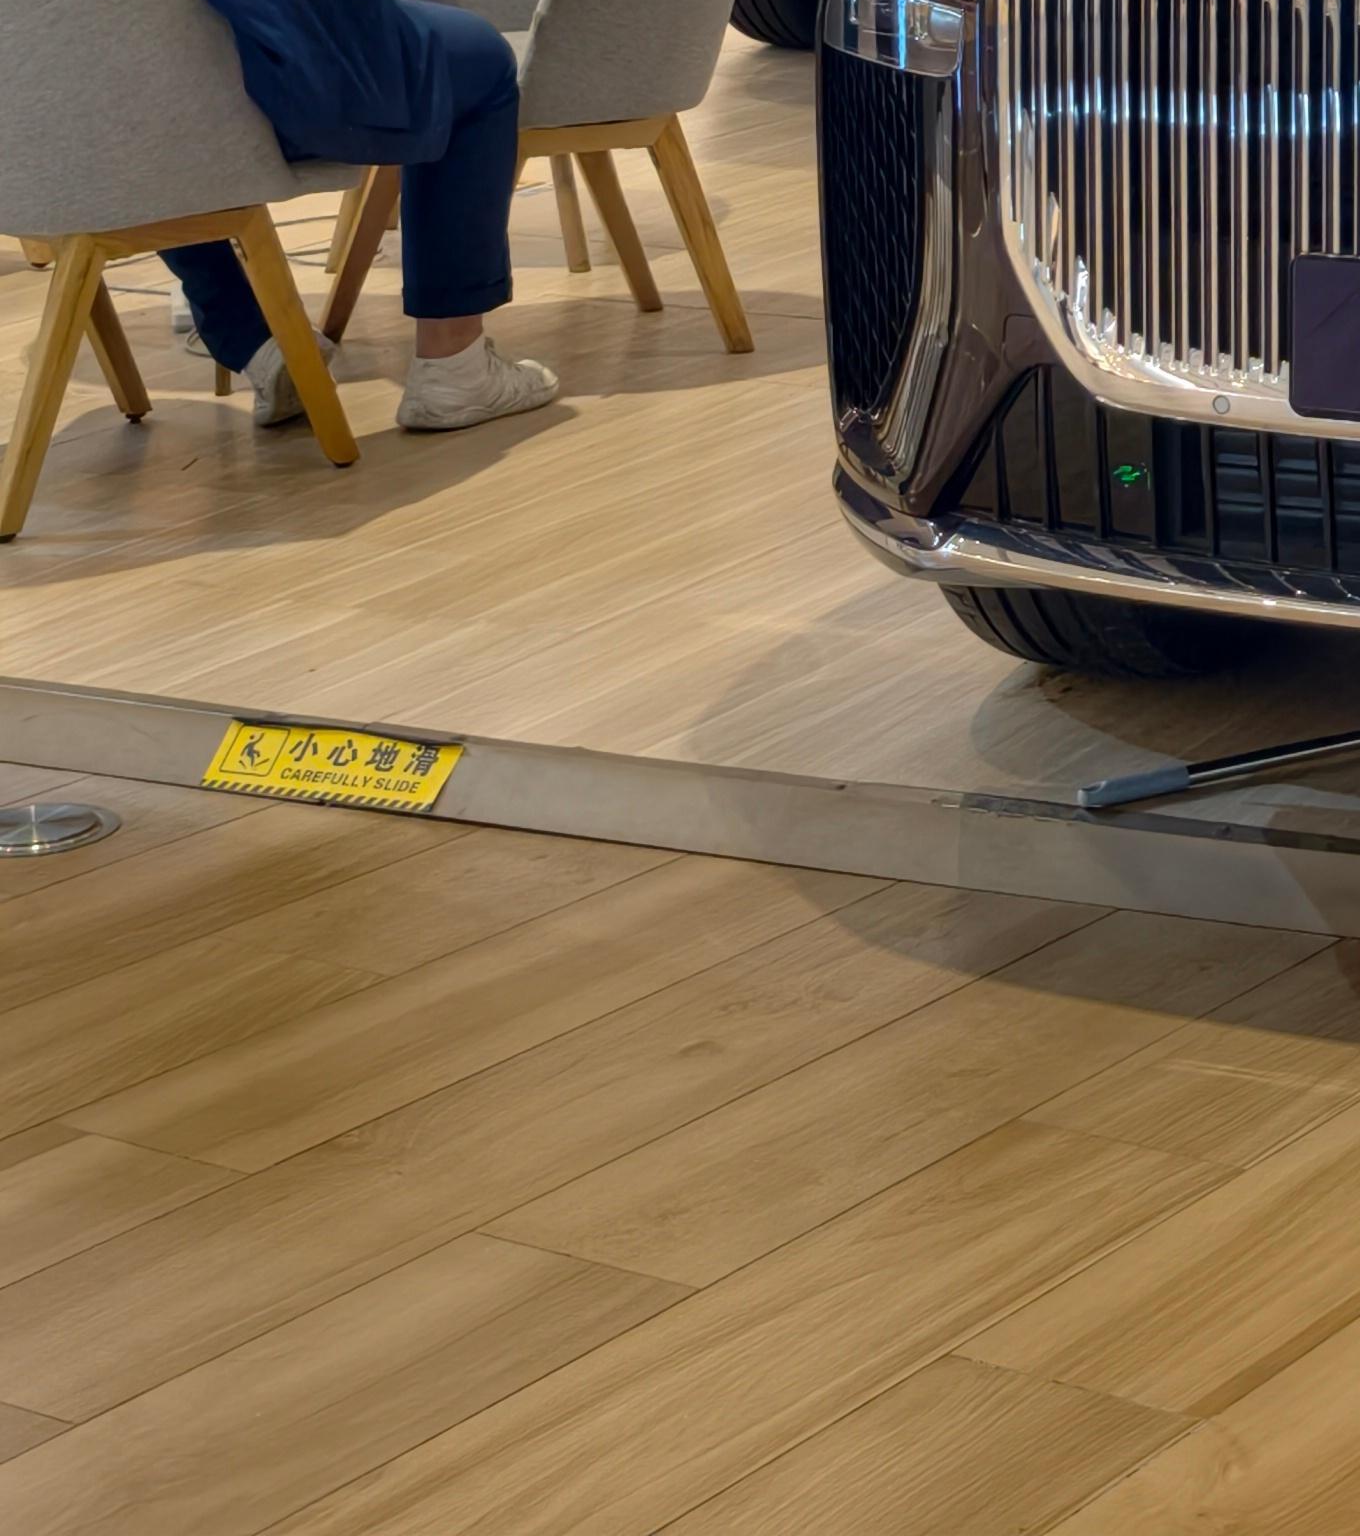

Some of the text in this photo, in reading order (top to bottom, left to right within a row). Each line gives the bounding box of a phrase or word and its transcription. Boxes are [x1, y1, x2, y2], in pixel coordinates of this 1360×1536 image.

[289, 732, 440, 778] 小心地滑
[279, 767, 422, 794] CAREFULLY SLIDE
